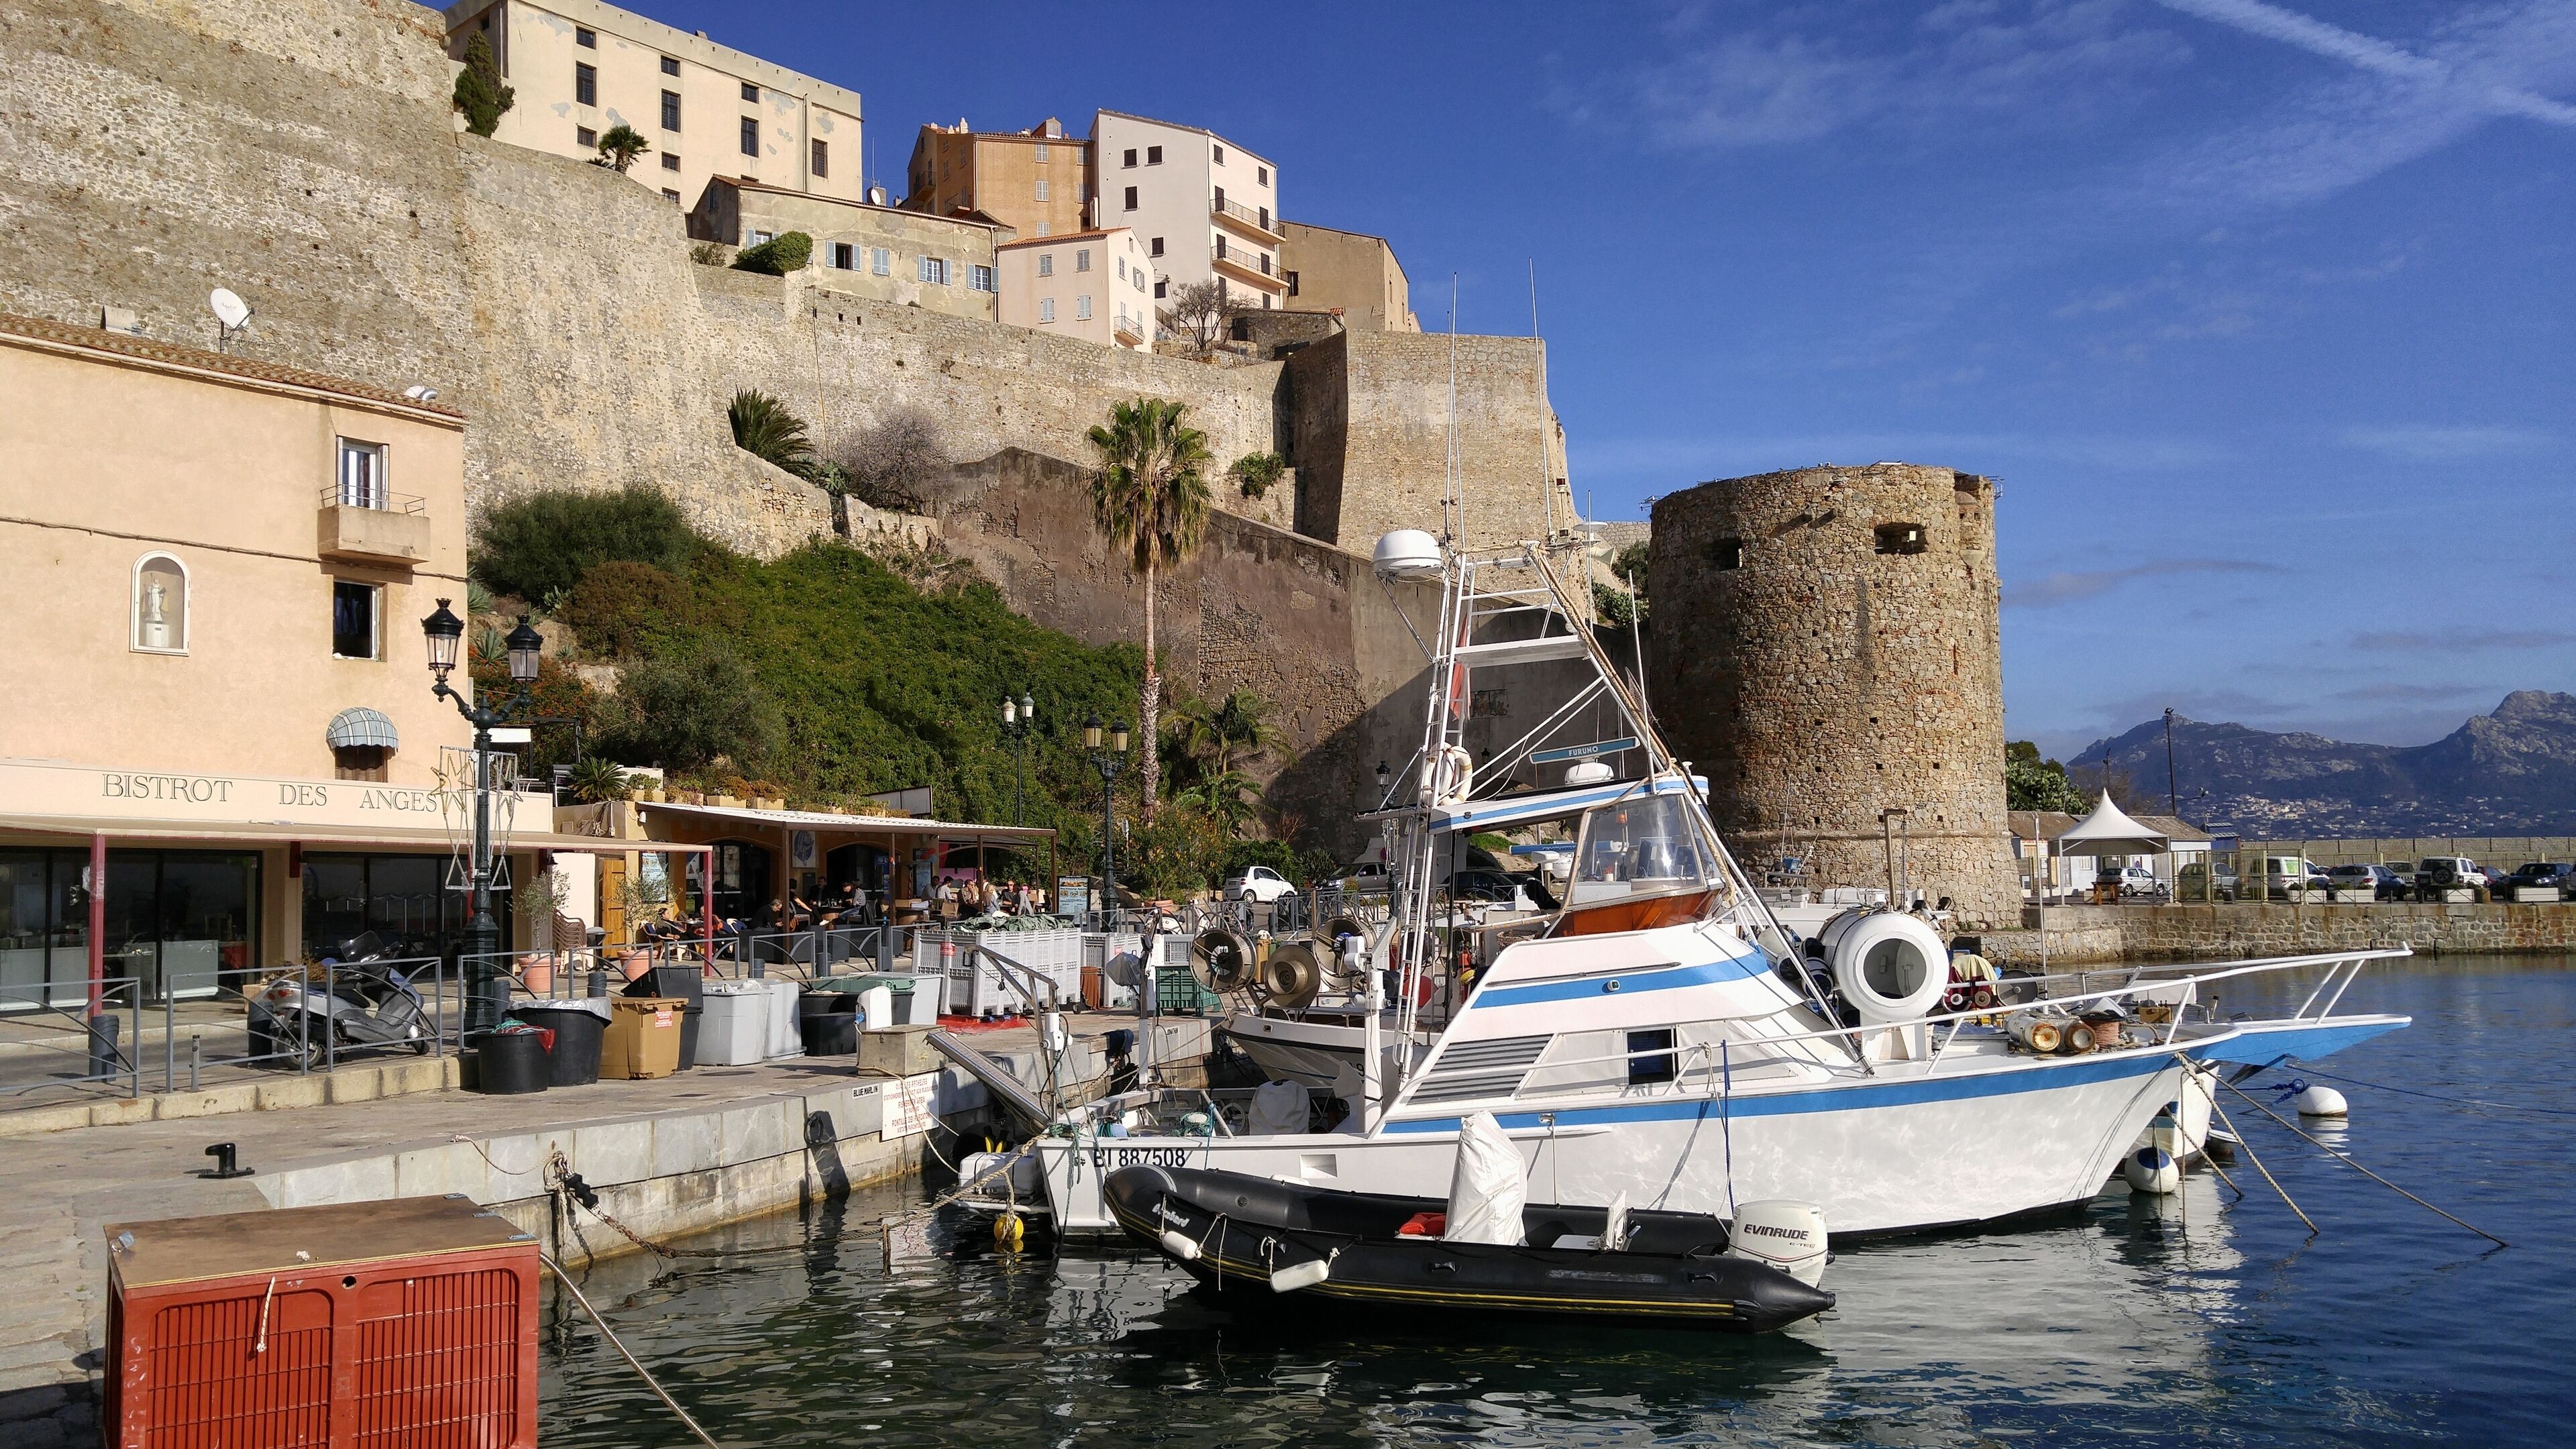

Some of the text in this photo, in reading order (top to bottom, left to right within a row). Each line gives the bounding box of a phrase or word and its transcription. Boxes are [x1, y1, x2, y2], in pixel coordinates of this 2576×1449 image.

[1568, 745, 1599, 757] FURUNO
[102, 773, 437, 812] BISTROT DES ANGES
[853, 1085, 878, 1097] BLUE MARLIN
[1094, 1148, 1186, 1168] BI 887508
[1744, 1223, 1809, 1240] EVINRUDE
